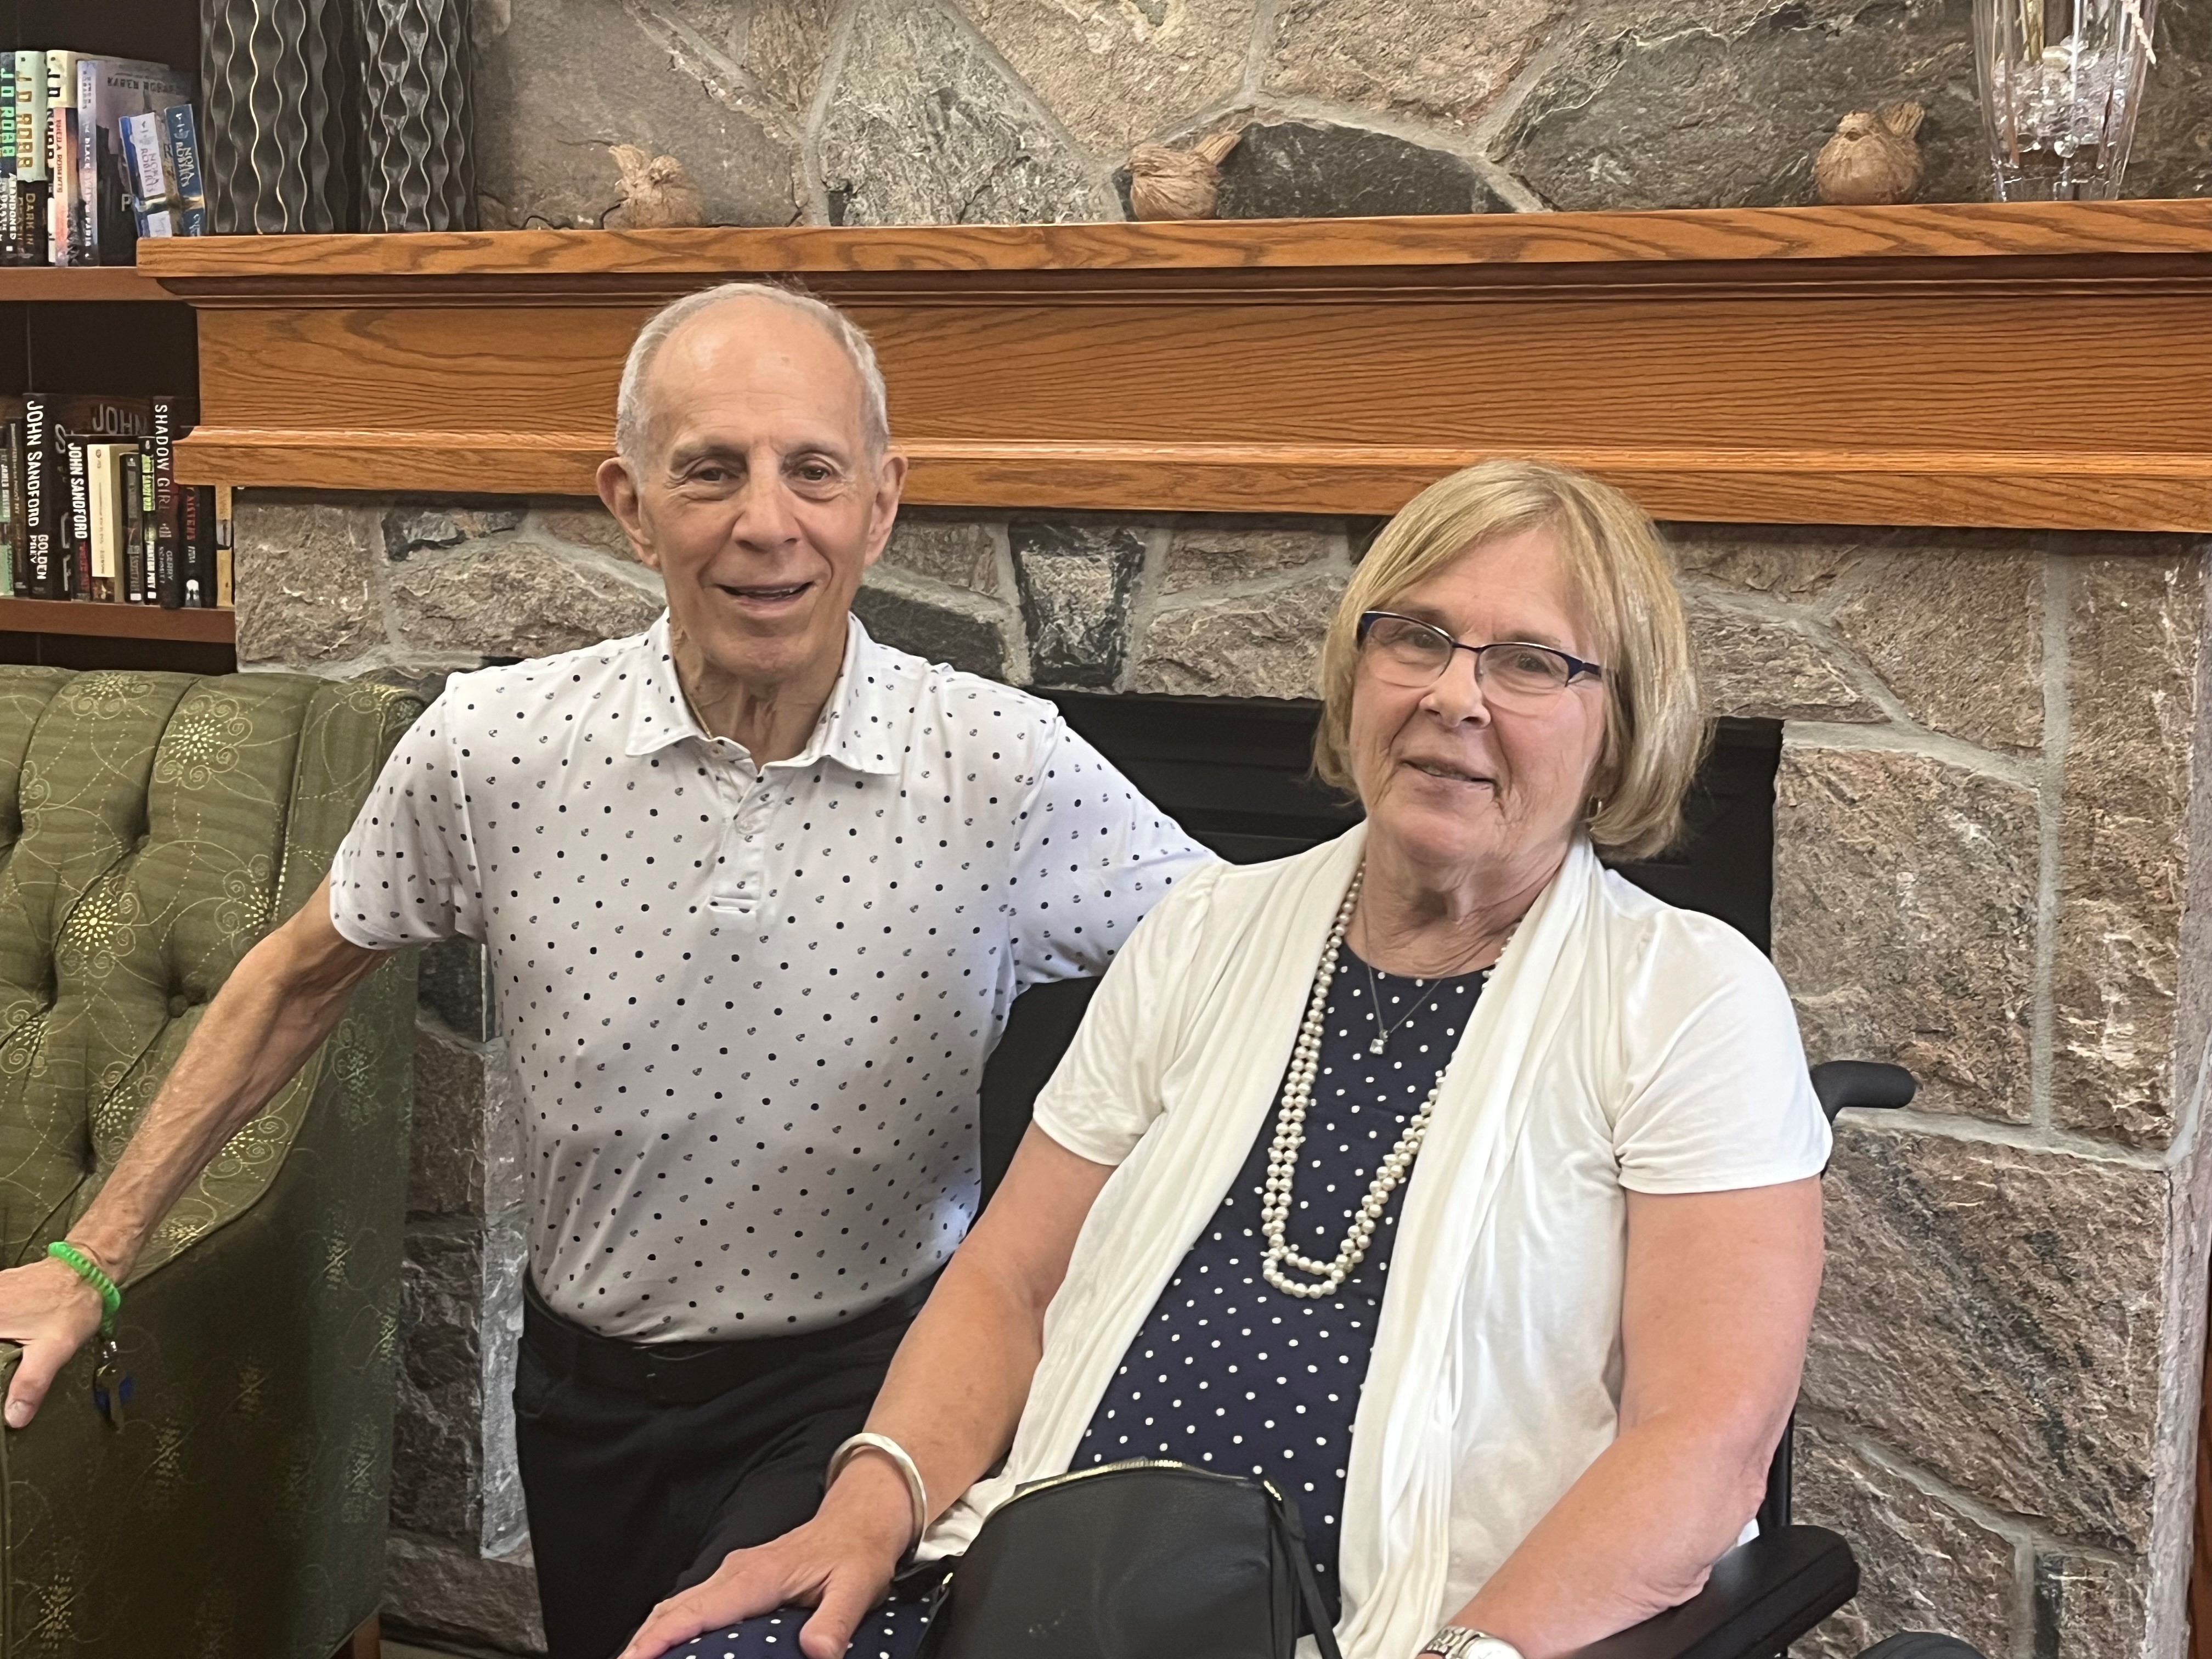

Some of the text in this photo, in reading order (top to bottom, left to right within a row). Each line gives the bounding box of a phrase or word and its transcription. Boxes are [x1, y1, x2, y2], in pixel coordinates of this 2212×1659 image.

[8, 173, 17, 240] ABANDONED
[26, 193, 36, 245] DARK IN
[92, 403, 148, 436] JOHN
[155, 404, 170, 470] SHADOW
[26, 400, 44, 527] JOHN SANDFORD
[67, 442, 82, 476] JOHN
[70, 477, 88, 539] SANDFORD
[157, 477, 171, 510] GIRL
